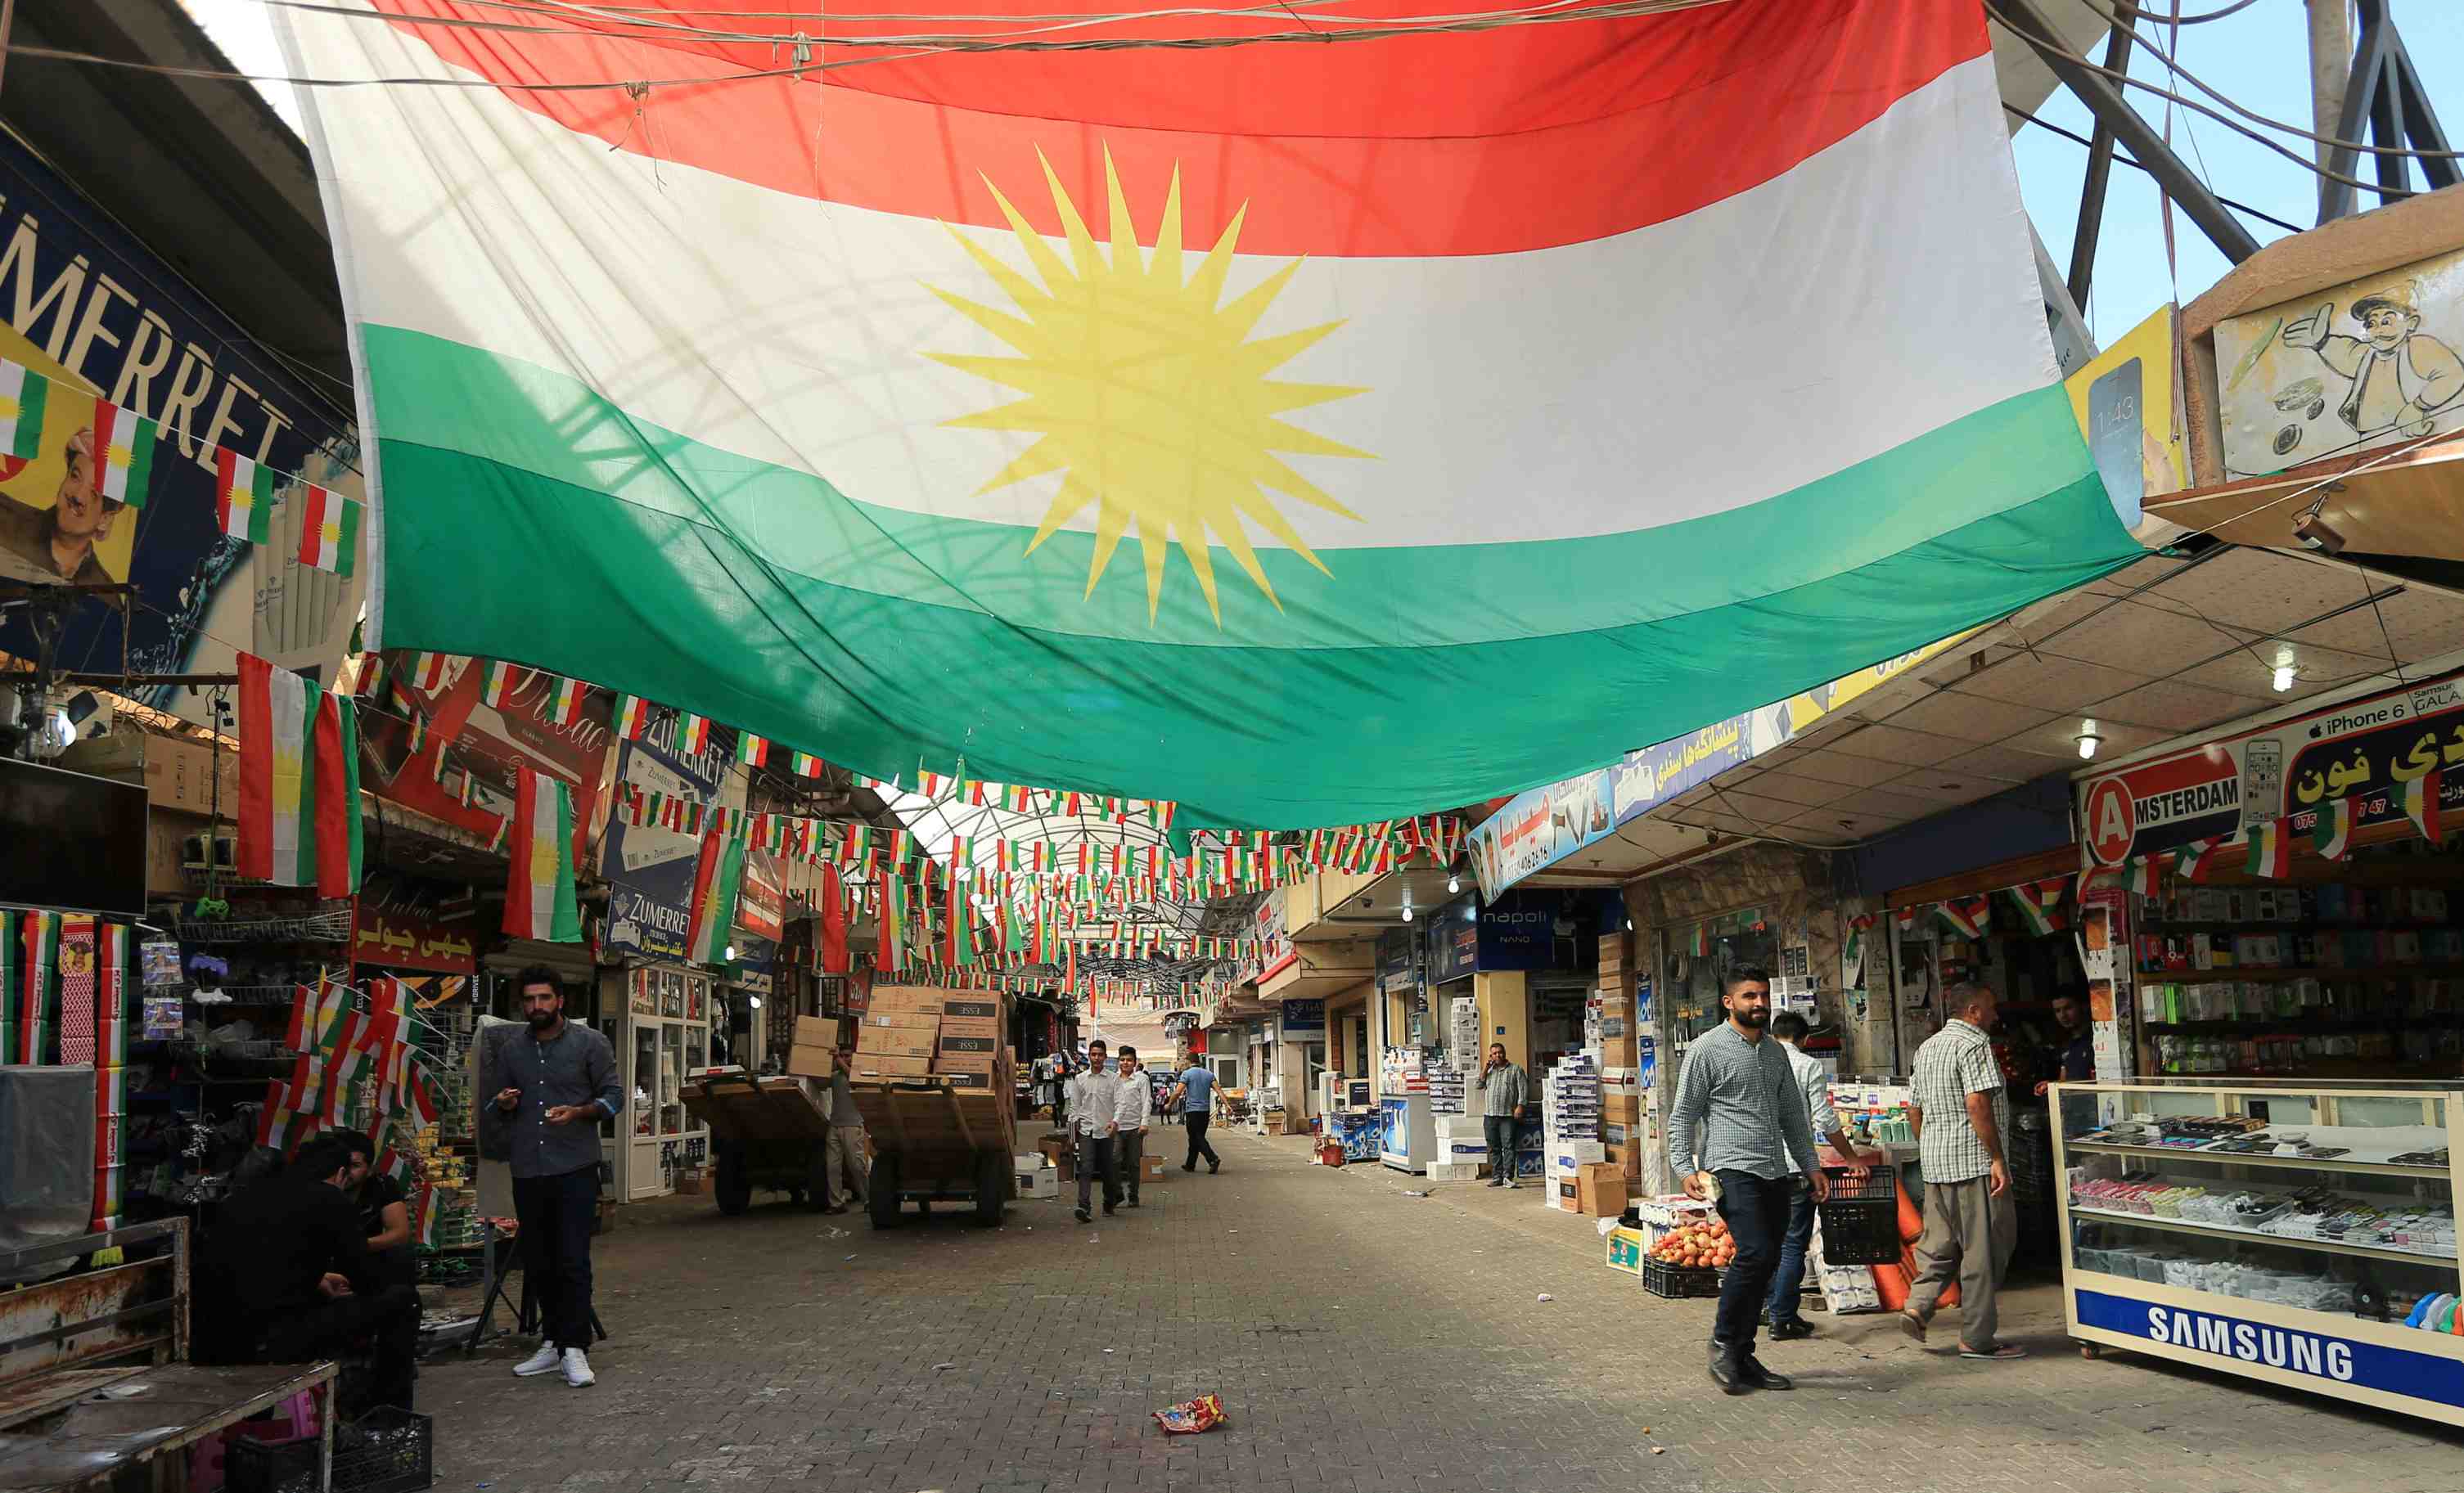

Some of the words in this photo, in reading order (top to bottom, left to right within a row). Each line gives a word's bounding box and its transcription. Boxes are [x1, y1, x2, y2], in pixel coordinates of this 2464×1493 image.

[0, 194, 293, 477] MERRET
[2327, 708, 2389, 735] iPhone
[2392, 704, 2405, 718] 6
[2298, 747, 2371, 803] فون
[629, 893, 691, 936] ZUMERRET
[1484, 910, 1547, 925] napoli
[2147, 1306, 2354, 1382] SAMSUNG
